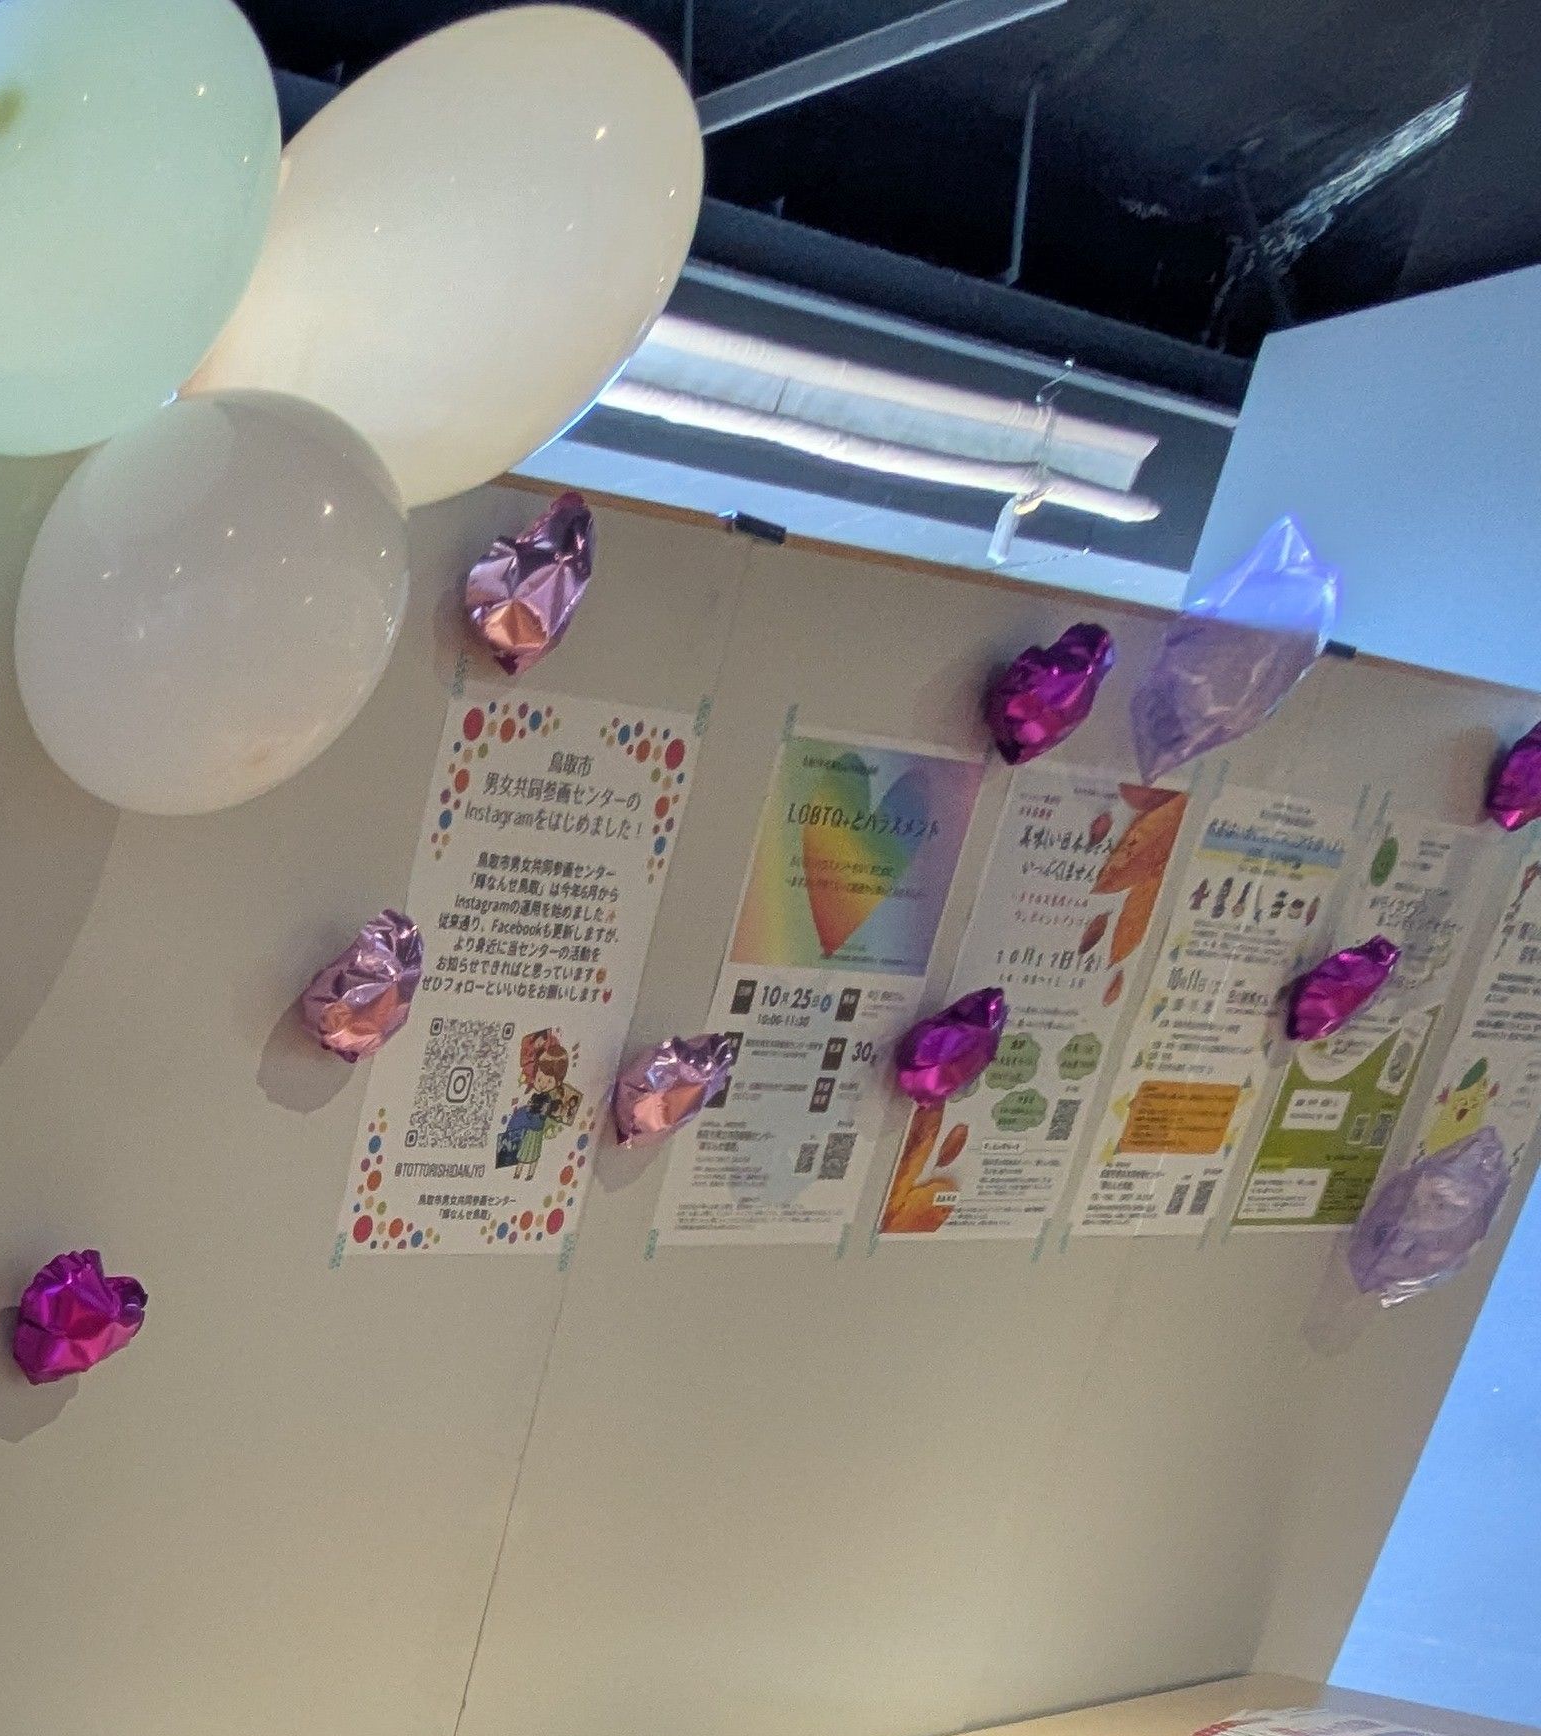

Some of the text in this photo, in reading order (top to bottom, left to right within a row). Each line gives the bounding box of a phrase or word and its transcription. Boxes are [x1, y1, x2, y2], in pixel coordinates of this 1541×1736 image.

[548, 751, 595, 777] 鳥取市
[483, 772, 641, 811] 男女共同参画センターの
